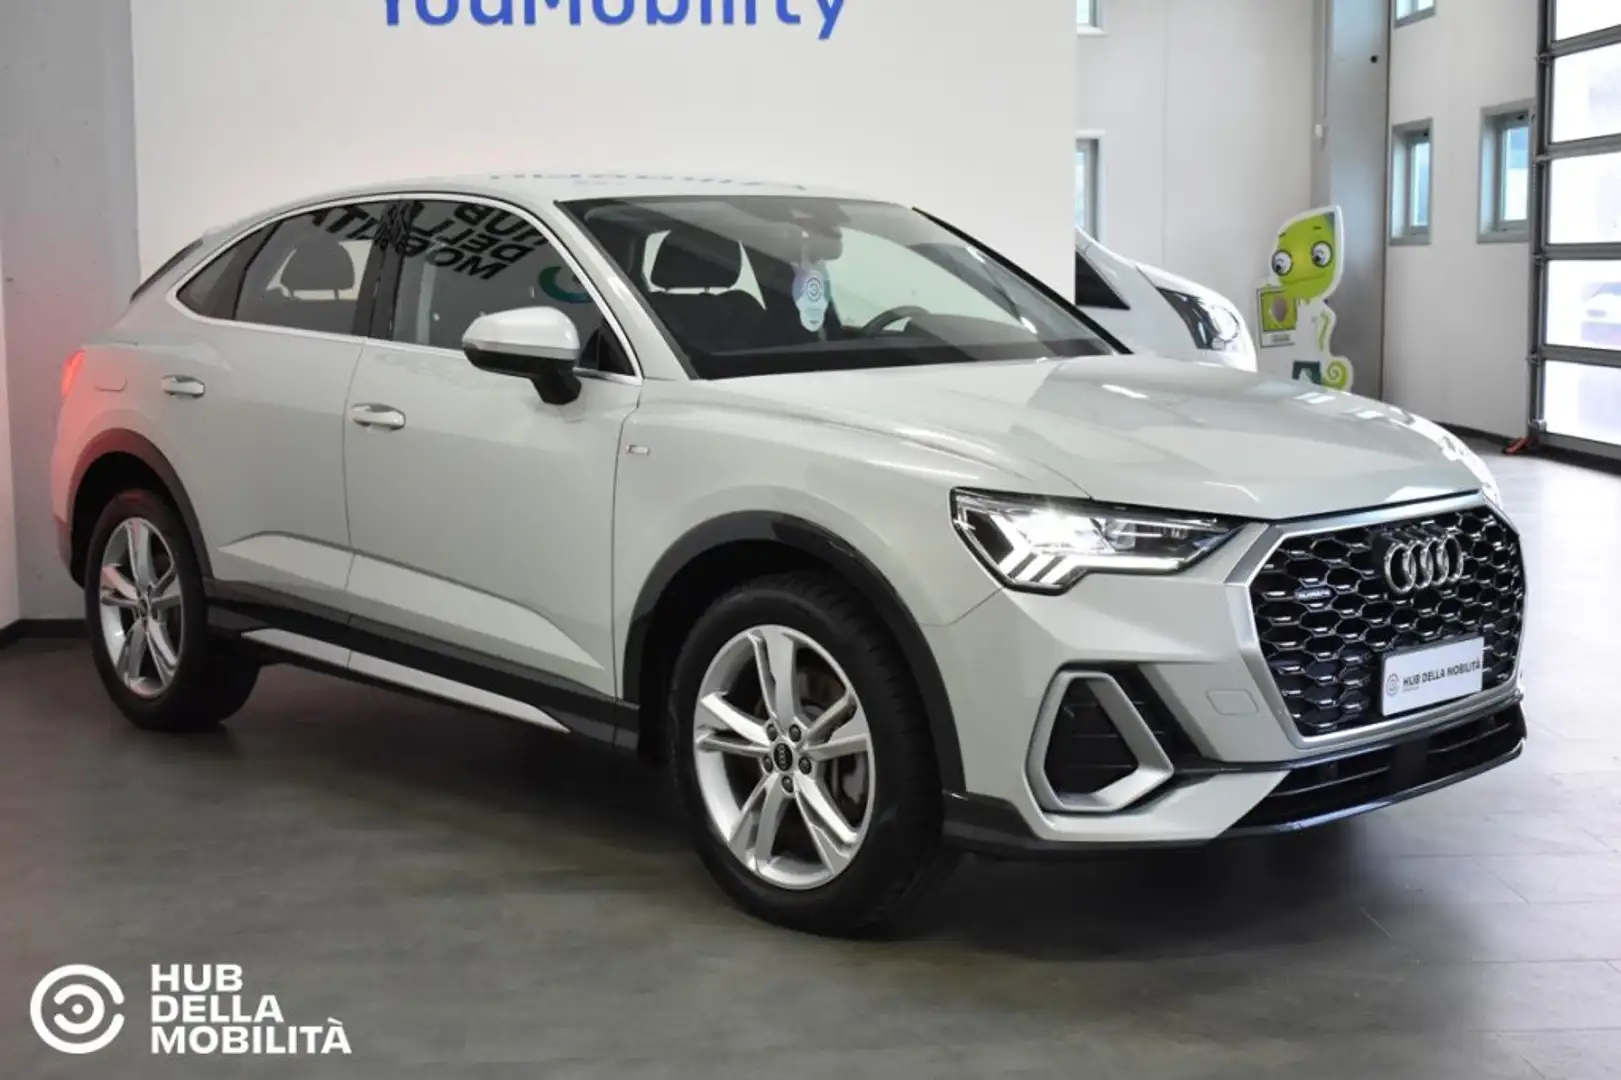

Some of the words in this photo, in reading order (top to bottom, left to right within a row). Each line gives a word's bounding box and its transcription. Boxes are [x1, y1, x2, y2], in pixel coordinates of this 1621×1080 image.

[1402, 673, 1421, 686] HUB
[1421, 668, 1445, 684] DELLA
[1447, 656, 1481, 677] MOBILITÀ
